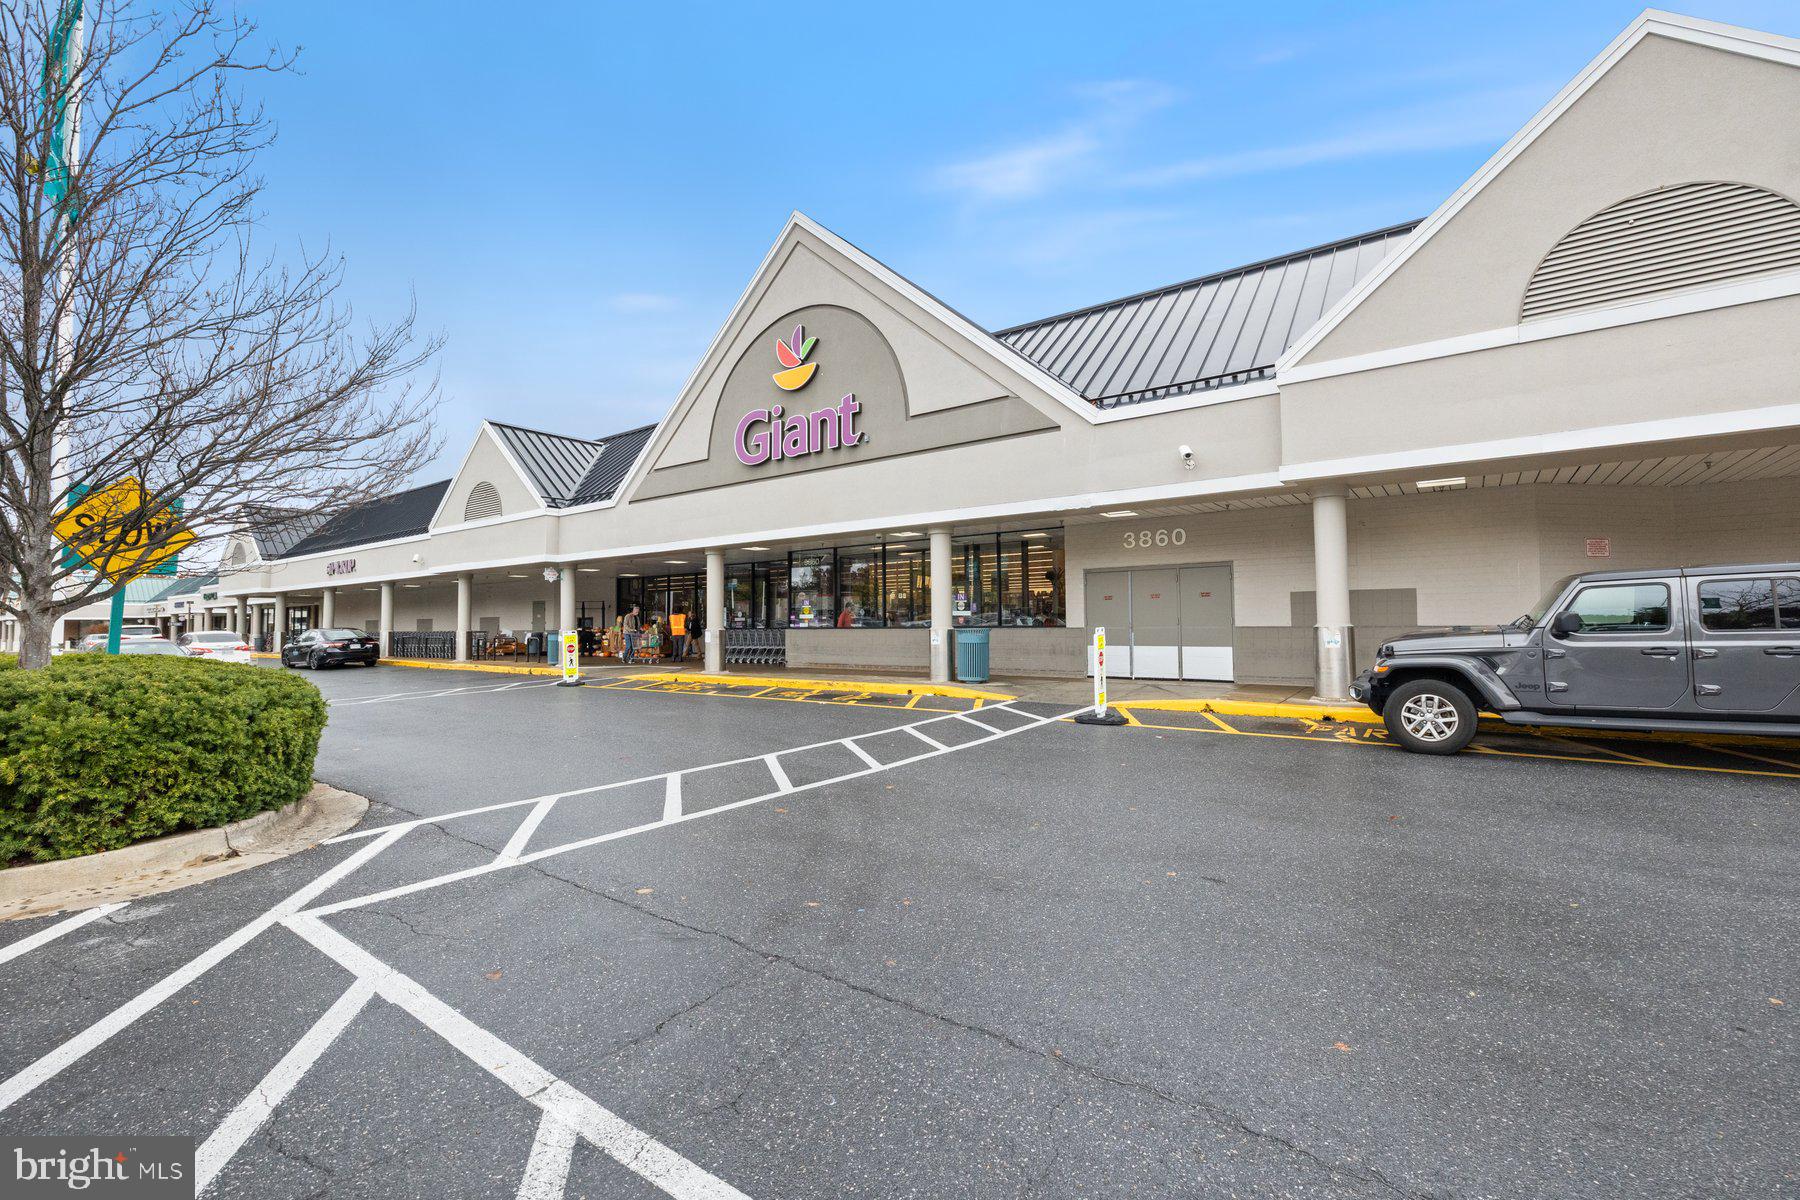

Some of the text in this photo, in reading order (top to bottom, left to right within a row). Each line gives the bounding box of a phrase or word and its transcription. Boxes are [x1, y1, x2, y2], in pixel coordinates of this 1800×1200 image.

[734, 393, 862, 466] Giant
[1123, 528, 1187, 549] 3860
[1514, 682, 1541, 691] Jeep
